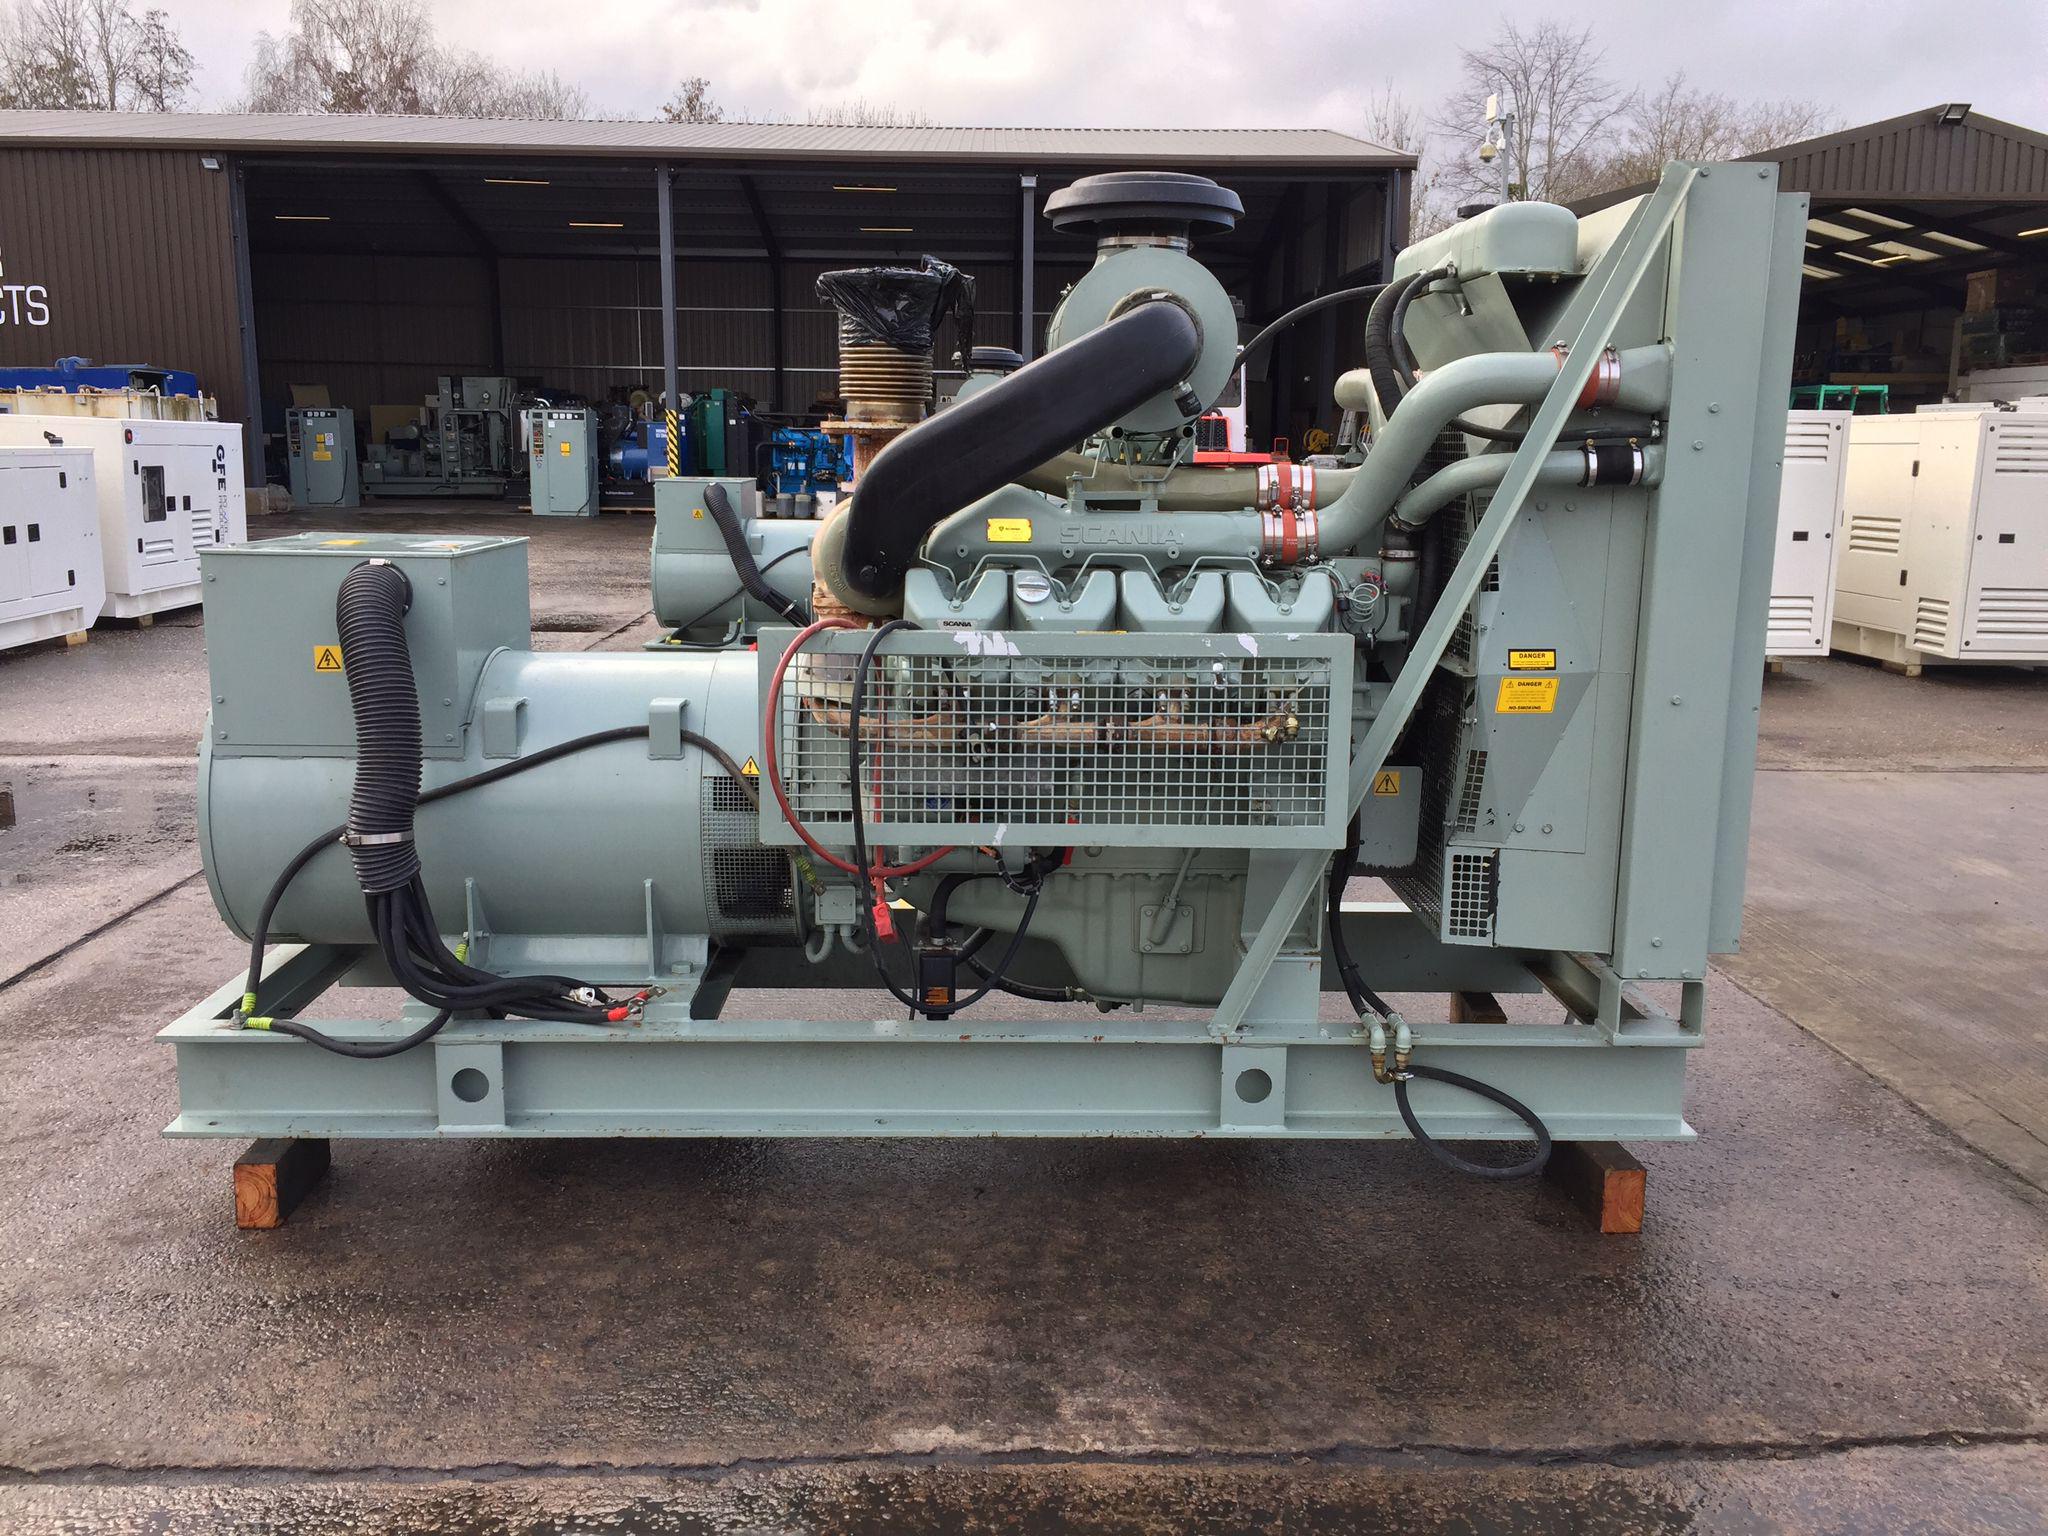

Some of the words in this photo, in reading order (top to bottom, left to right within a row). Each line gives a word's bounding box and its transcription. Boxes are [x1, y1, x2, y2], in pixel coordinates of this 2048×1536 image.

[0, 285, 50, 326] TS
[216, 445, 226, 491] GFE
[1060, 525, 1184, 545] SCANIA
